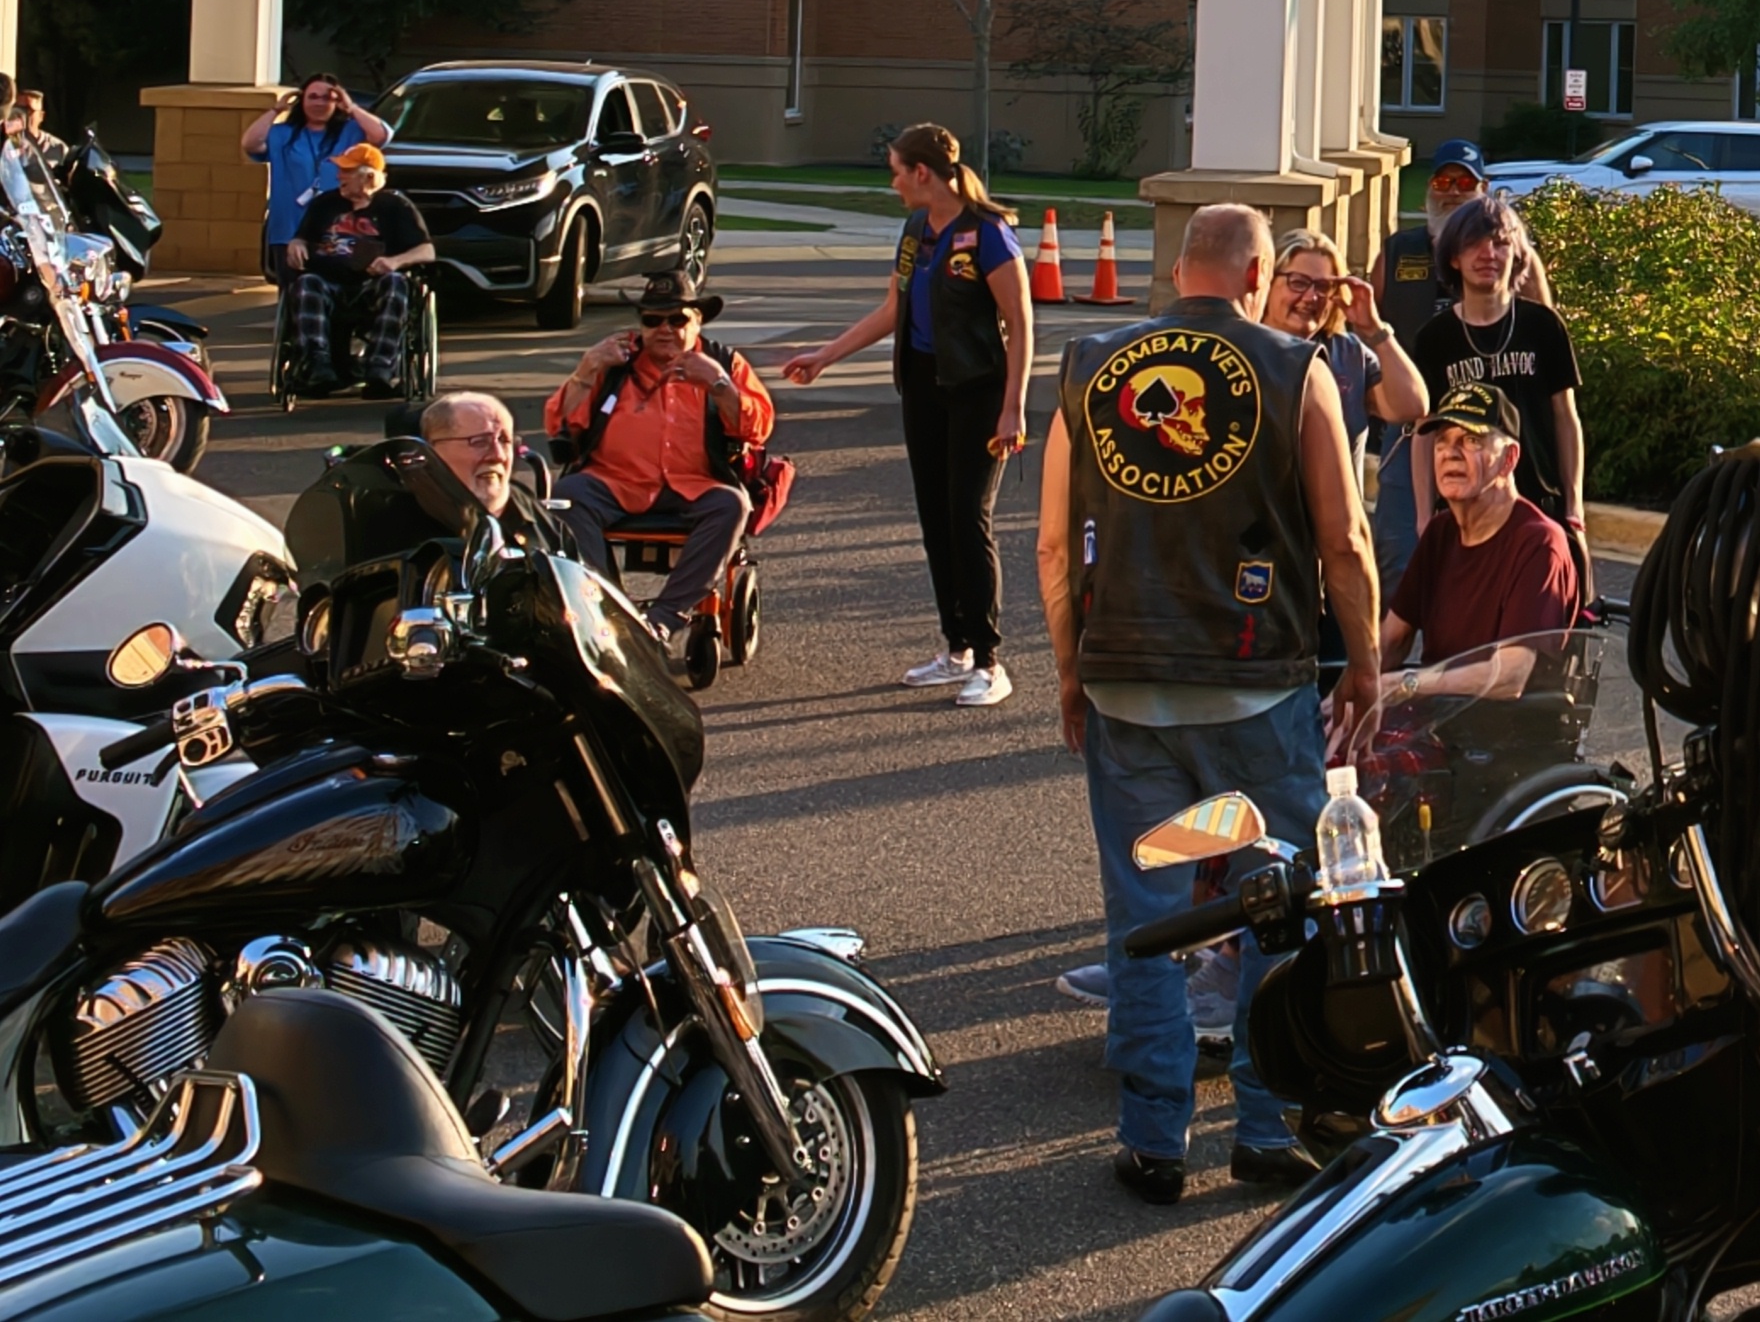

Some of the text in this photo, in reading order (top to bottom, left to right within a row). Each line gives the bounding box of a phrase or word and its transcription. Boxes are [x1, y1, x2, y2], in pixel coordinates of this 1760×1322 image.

[1096, 334, 1252, 397] COMBAT VETS
[1096, 426, 1248, 497] ASSOCIATION
[75, 768, 155, 785] PURSUIT
